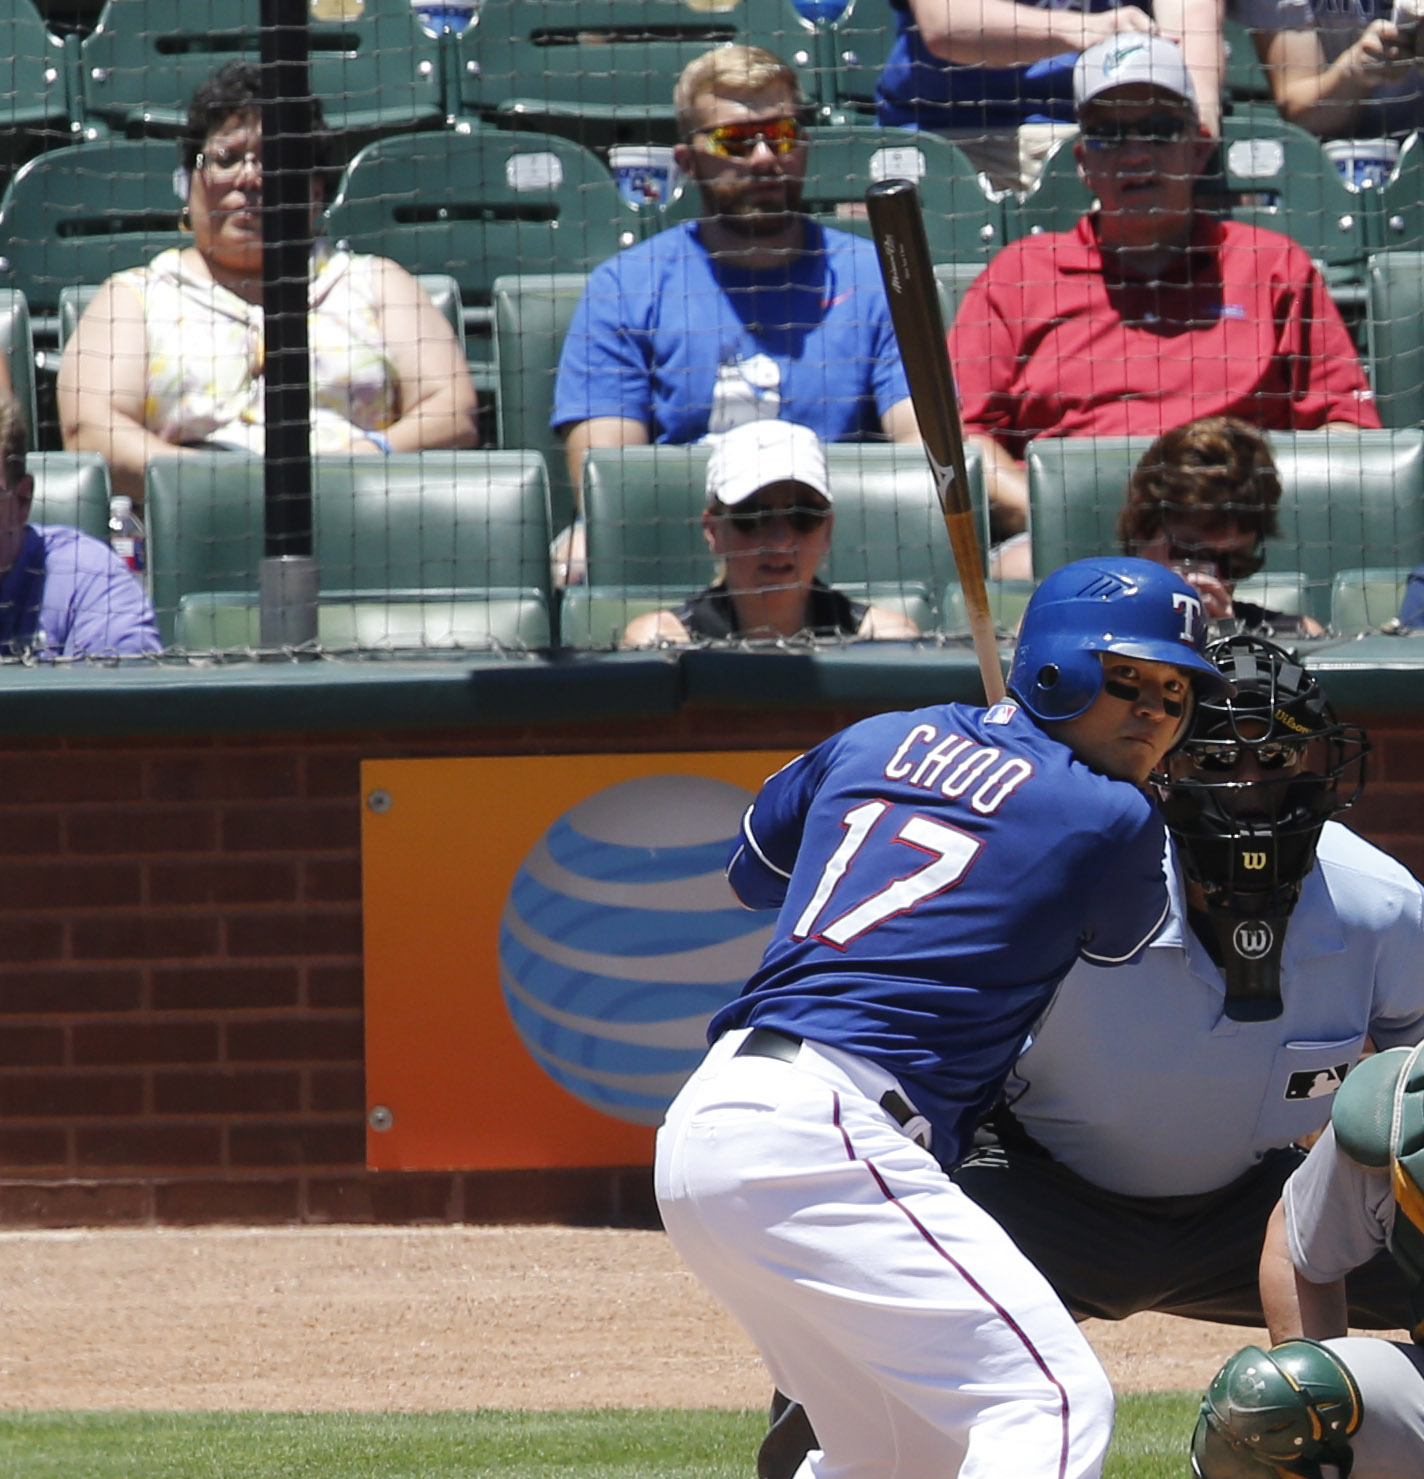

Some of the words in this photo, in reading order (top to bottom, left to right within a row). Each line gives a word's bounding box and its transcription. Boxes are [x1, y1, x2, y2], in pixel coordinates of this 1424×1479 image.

[1171, 592, 1202, 645] T
[1274, 708, 1314, 735] Wilson
[884, 723, 1034, 817] CHOO
[790, 798, 987, 952] 17
